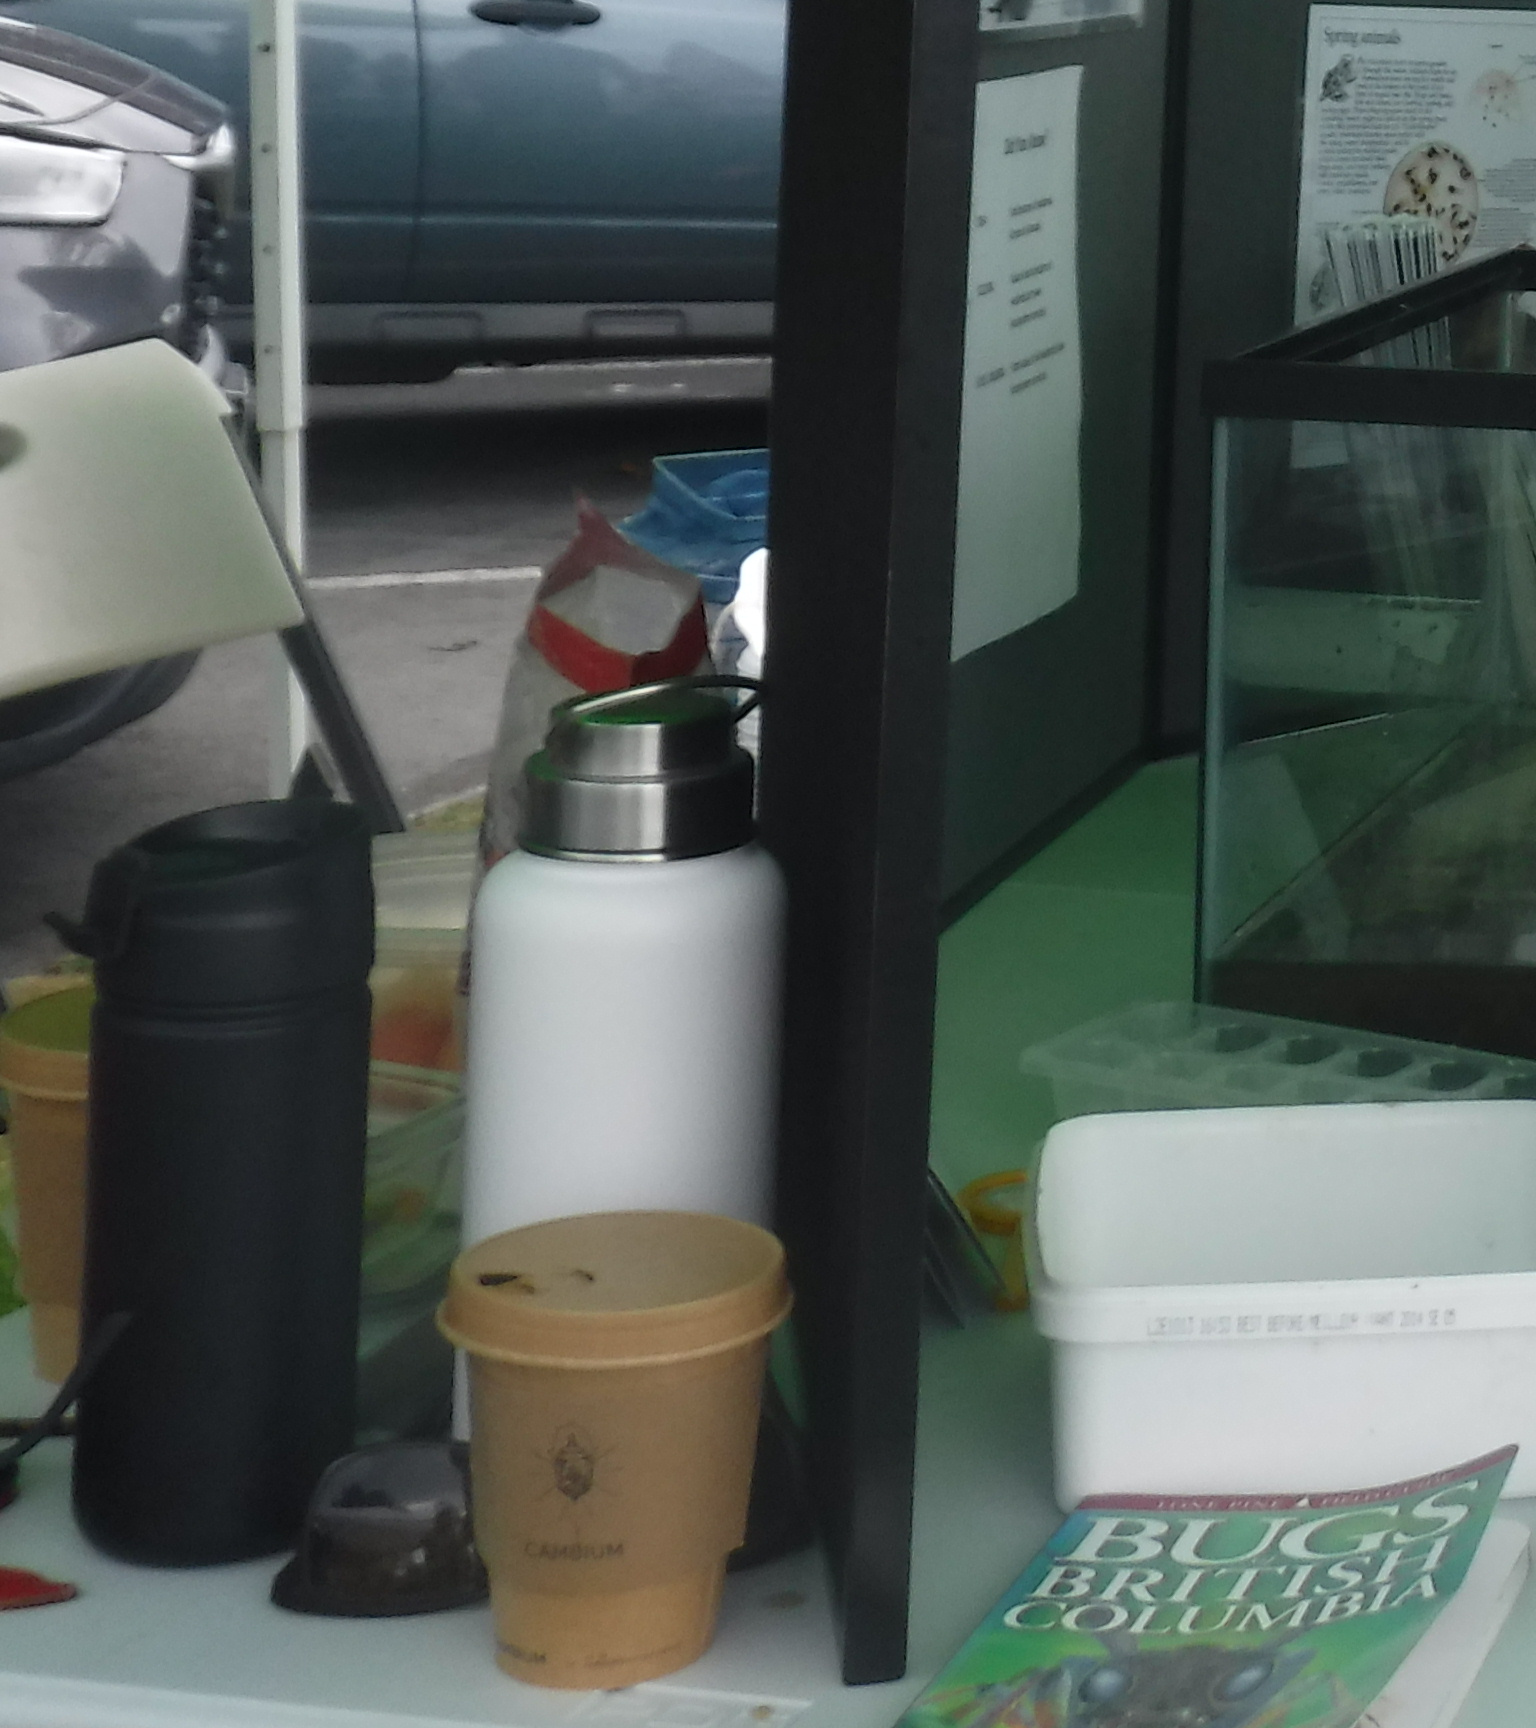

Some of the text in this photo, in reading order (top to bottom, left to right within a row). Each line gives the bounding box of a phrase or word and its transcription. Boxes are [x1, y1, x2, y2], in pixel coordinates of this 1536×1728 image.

[523, 1541, 624, 1562] CAMBIUM
[1054, 1478, 1478, 1569] BUGS
[1030, 1534, 1448, 1604] BRITISH
[1003, 1571, 1438, 1636] COLUMBIA
